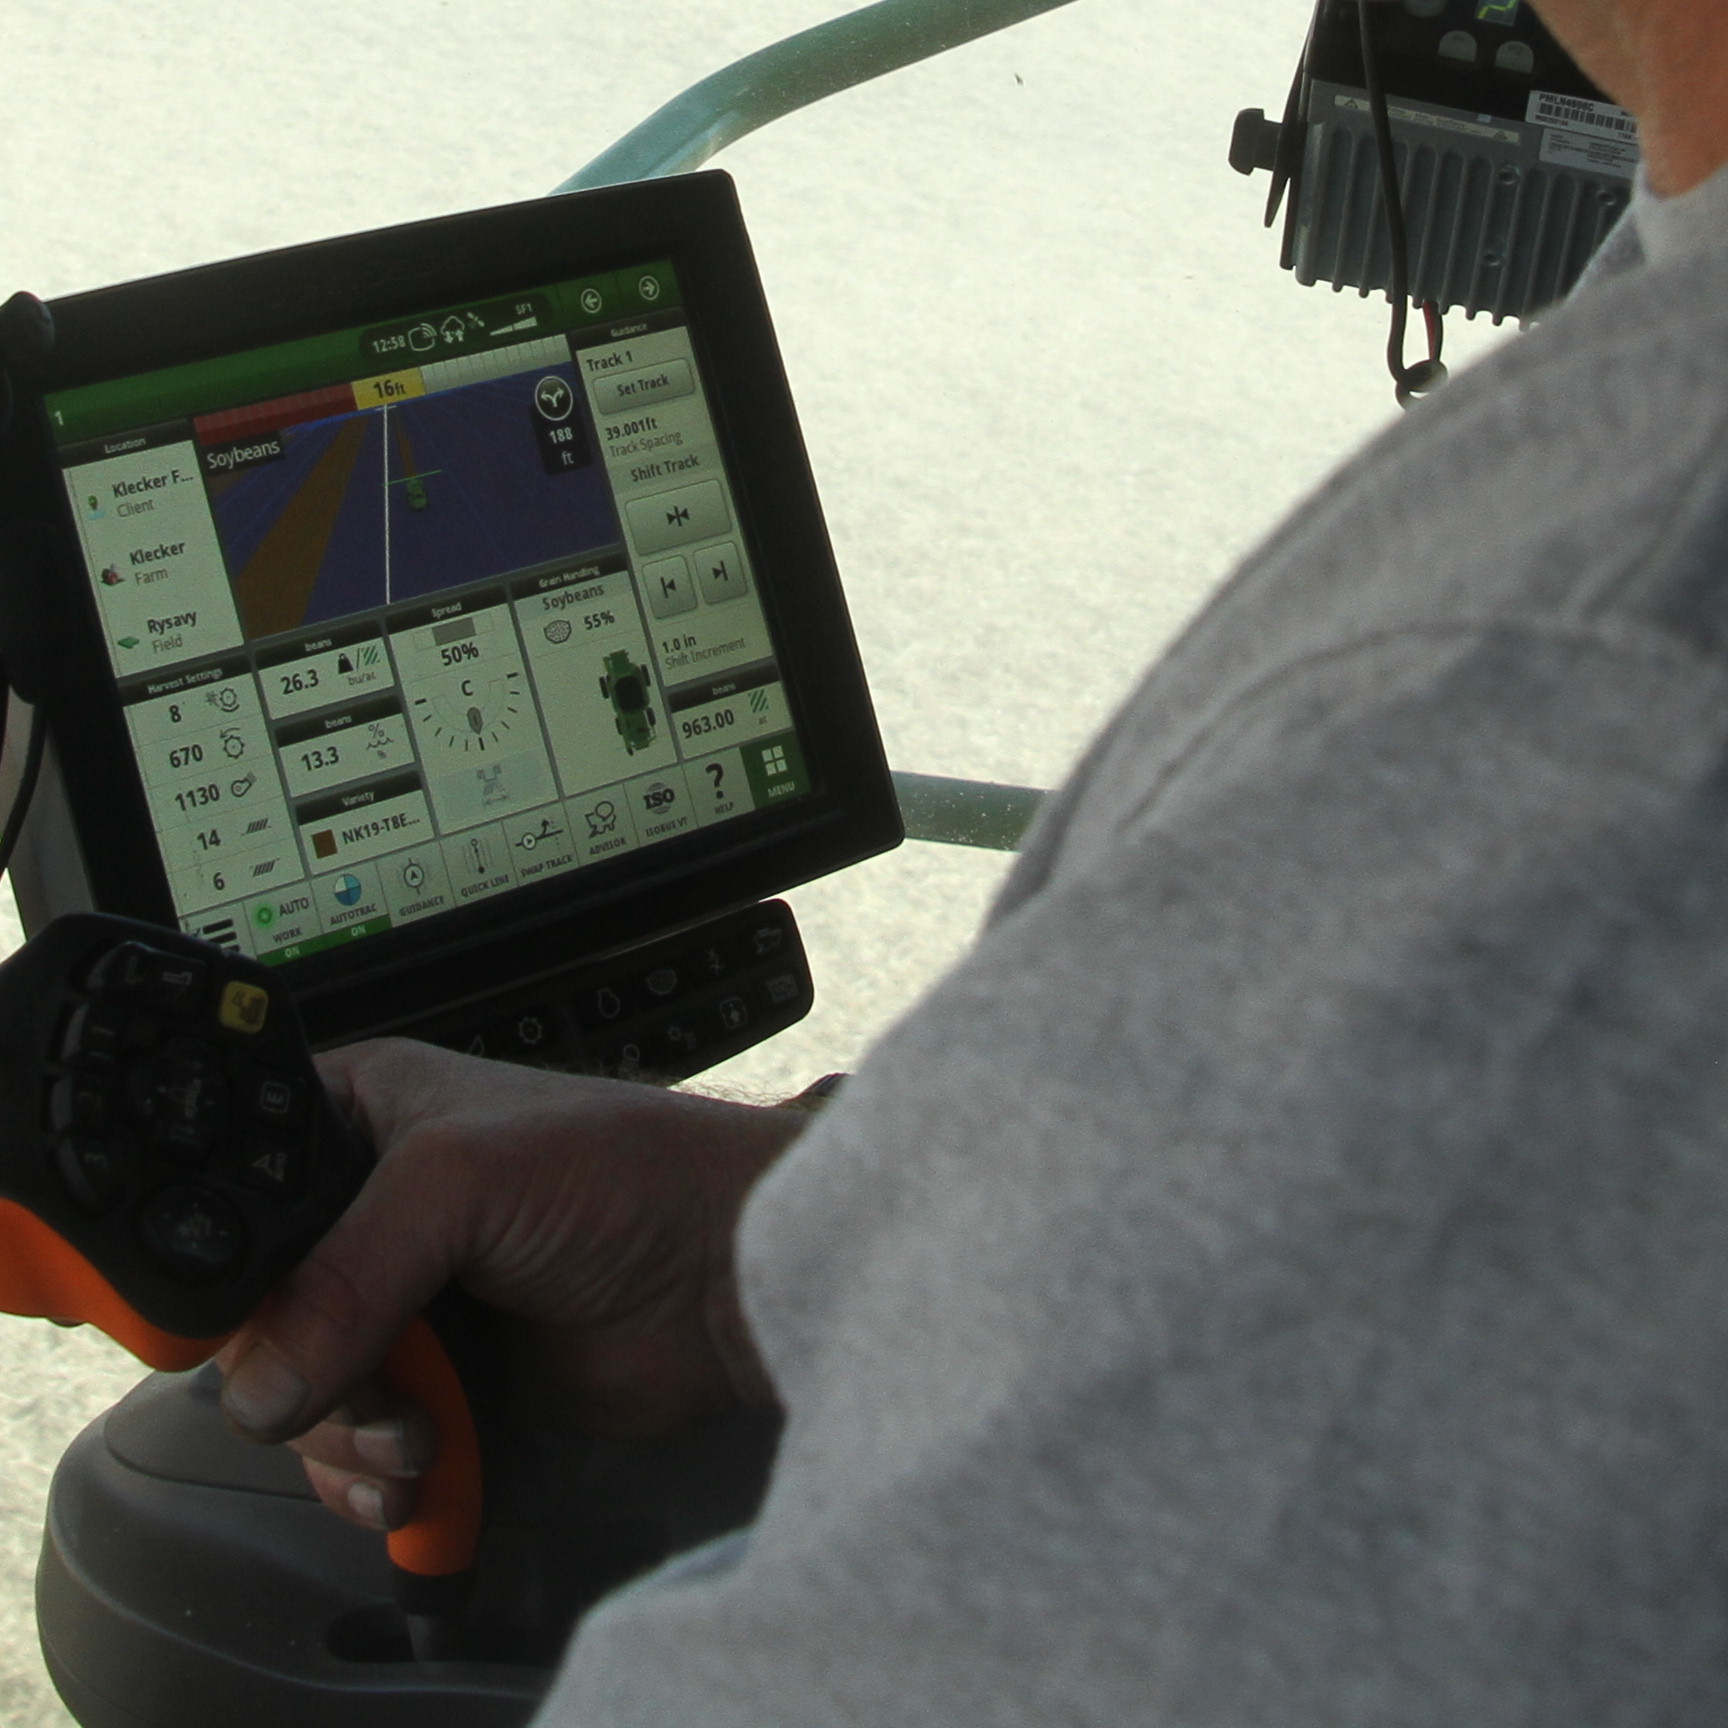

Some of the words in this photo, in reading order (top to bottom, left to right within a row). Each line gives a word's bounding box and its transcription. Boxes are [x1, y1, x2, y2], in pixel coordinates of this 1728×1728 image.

[515, 303, 532, 315] SF1
[610, 323, 647, 337] Guidance
[372, 335, 406, 353] 12:58
[586, 354, 623, 371] Track
[626, 351, 633, 362] 1
[373, 379, 406, 399] 16ft
[617, 381, 636, 397] Set
[637, 374, 669, 392] Track
[54, 410, 64, 425] 1
[549, 427, 572, 444] 188
[605, 417, 658, 441] 39.001ft
[104, 437, 146, 454] Location
[206, 439, 281, 469] Soybeans
[609, 439, 639, 458] Track
[640, 432, 683, 452] Spacing
[561, 451, 574, 465] ft
[631, 464, 662, 482] Shift
[664, 454, 700, 472] Track
[111, 475, 169, 499] Klecker
[117, 499, 154, 518] Client
[129, 542, 185, 565] Klecker
[135, 567, 169, 586] Farm
[542, 584, 604, 611] Soybeans
[431, 602, 462, 619] Spread
[584, 610, 615, 630] 55%
[147, 610, 197, 636] Rysavy
[152, 634, 184, 654] Field
[305, 638, 332, 652] beans
[441, 642, 479, 666] 50%
[662, 637, 681, 653] 1.0
[683, 635, 697, 648] in
[665, 654, 690, 671] Shift
[692, 637, 746, 662] Increment
[148, 677, 184, 694] Harvest
[185, 668, 223, 686] Settings
[281, 669, 319, 695] 26.3
[348, 672, 376, 686] bu/ac
[712, 682, 736, 696] beans
[169, 705, 182, 723] 8
[325, 714, 352, 729] beans
[682, 709, 735, 739] 963.00
[169, 744, 203, 769] 670
[301, 746, 339, 771] 13.3
[175, 783, 220, 811] 1130
[342, 791, 375, 807] Variety
[643, 788, 674, 810] ISO
[767, 781, 795, 797] MENU
[714, 802, 734, 815] HELP
[197, 829, 221, 850] 14
[589, 837, 627, 855] ADVISOR
[546, 854, 573, 869] TRACK
[213, 872, 225, 890] 6
[461, 881, 489, 897] QUICK
[490, 874, 510, 888] LINE
[279, 897, 309, 917] AUTO
[330, 903, 377, 925] AUTOTRAC
[399, 895, 445, 917] GUIDANCE
[273, 927, 303, 944] WORK
[351, 925, 366, 937] ON
[285, 946, 300, 958] ON
